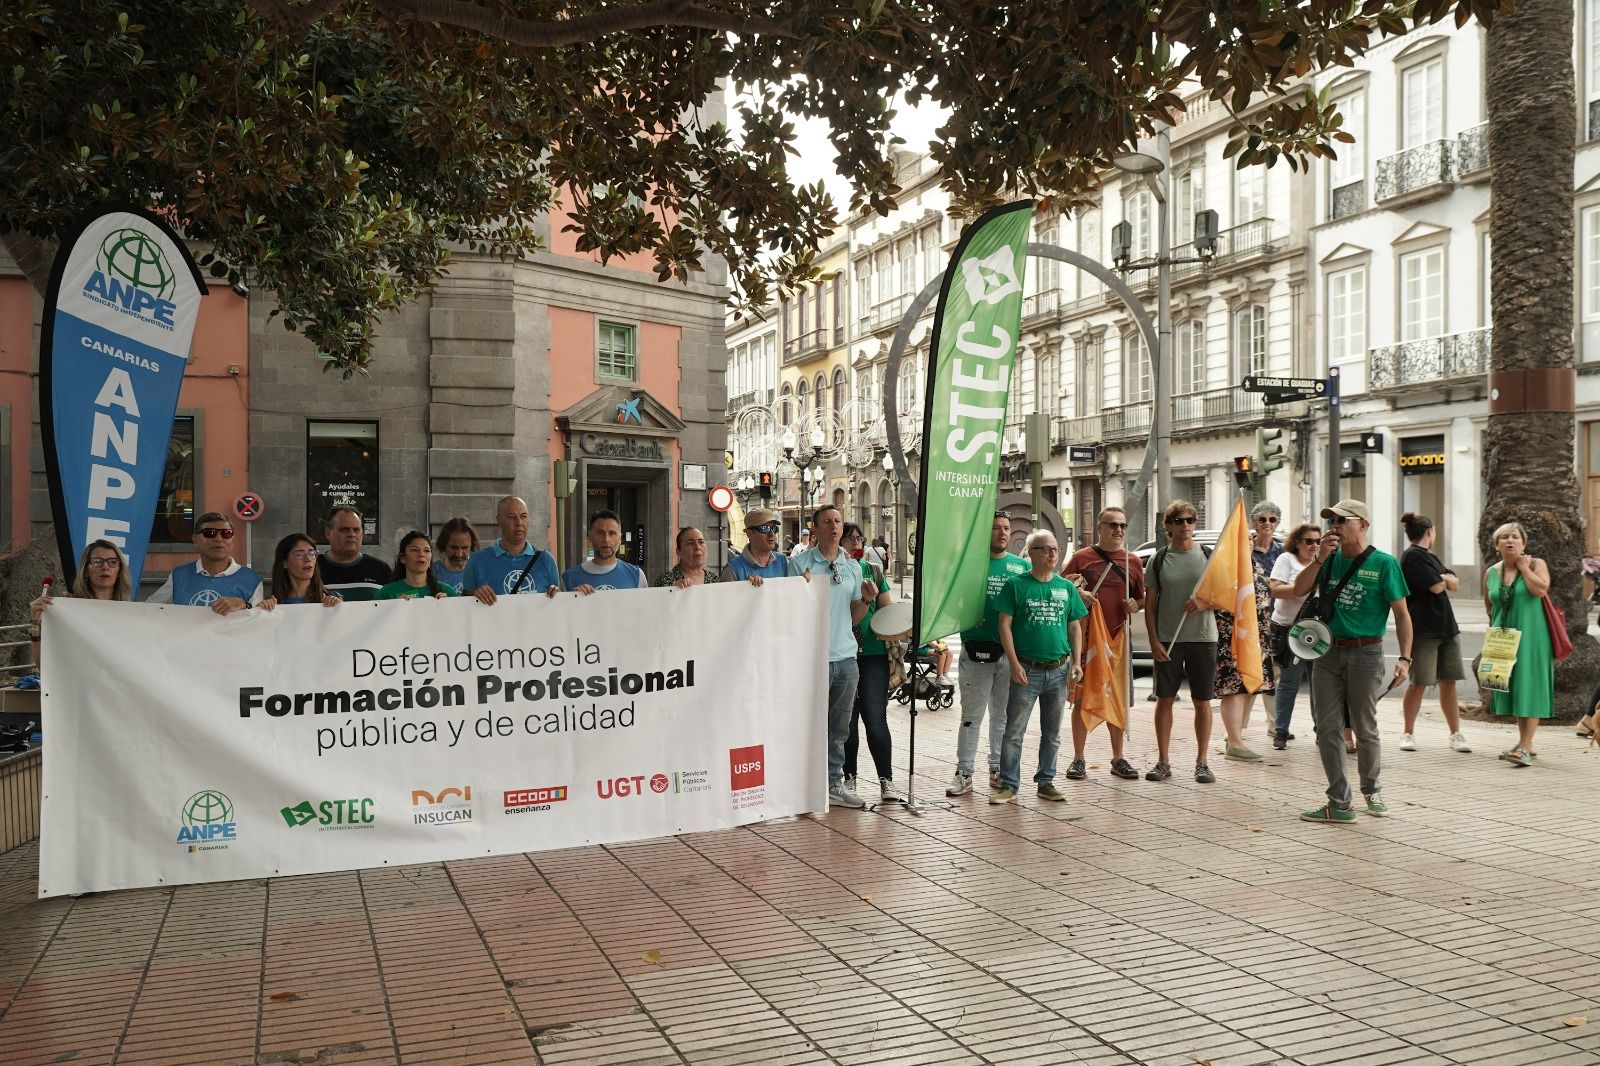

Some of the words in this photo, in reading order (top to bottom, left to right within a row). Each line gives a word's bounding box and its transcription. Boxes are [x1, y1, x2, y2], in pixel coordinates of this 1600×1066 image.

[84, 270, 177, 327] ANPE
[82, 291, 119, 312] SINDICATO
[120, 308, 174, 332] INDEPENDIENTE
[80, 336, 160, 373] CANARIAS
[946, 320, 1013, 465] STEC
[1282, 379, 1290, 387] DE
[580, 432, 663, 459] CaixaBank
[86, 365, 141, 567] ANPE
[1399, 452, 1448, 467] banana
[328, 482, 360, 491] Ayúdales
[352, 644, 566, 679] Defendemos
[576, 638, 601, 666] la
[239, 678, 466, 718] Formación
[476, 659, 696, 704] Profesional
[316, 716, 438, 756] pública
[447, 718, 465, 747] y
[474, 711, 514, 739] de
[524, 701, 636, 735] calidad
[682, 770, 708, 778] Servicios
[734, 761, 761, 774] USPS
[507, 790, 548, 804] CCOO
[597, 776, 645, 799] UGT
[318, 798, 375, 825] STEC
[414, 809, 472, 825] INSUCAN
[505, 804, 551, 815] enseñanza
[176, 823, 237, 842] ANPE
